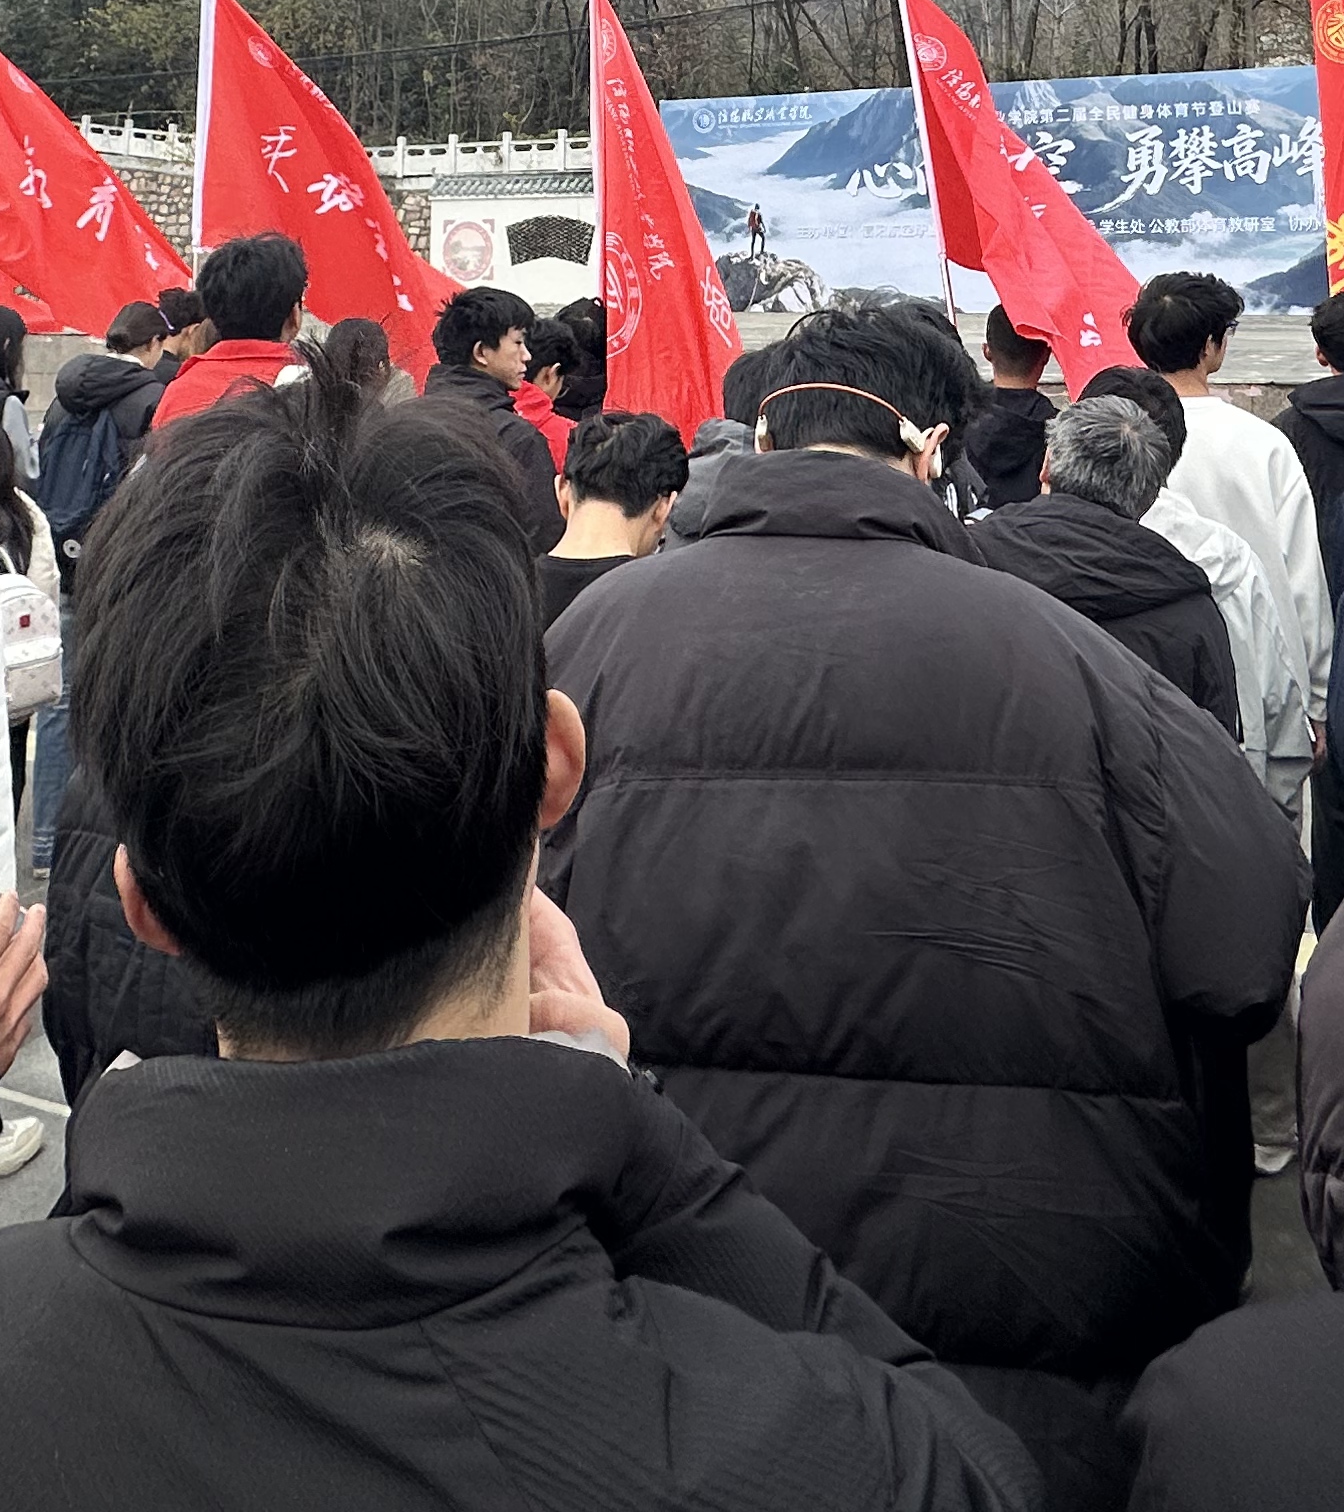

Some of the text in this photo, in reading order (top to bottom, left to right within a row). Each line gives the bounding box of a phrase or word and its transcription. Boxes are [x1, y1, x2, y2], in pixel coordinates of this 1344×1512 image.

[1083, 115, 1327, 215] 勇攀高峰
[1099, 218, 1147, 235] 学生处
